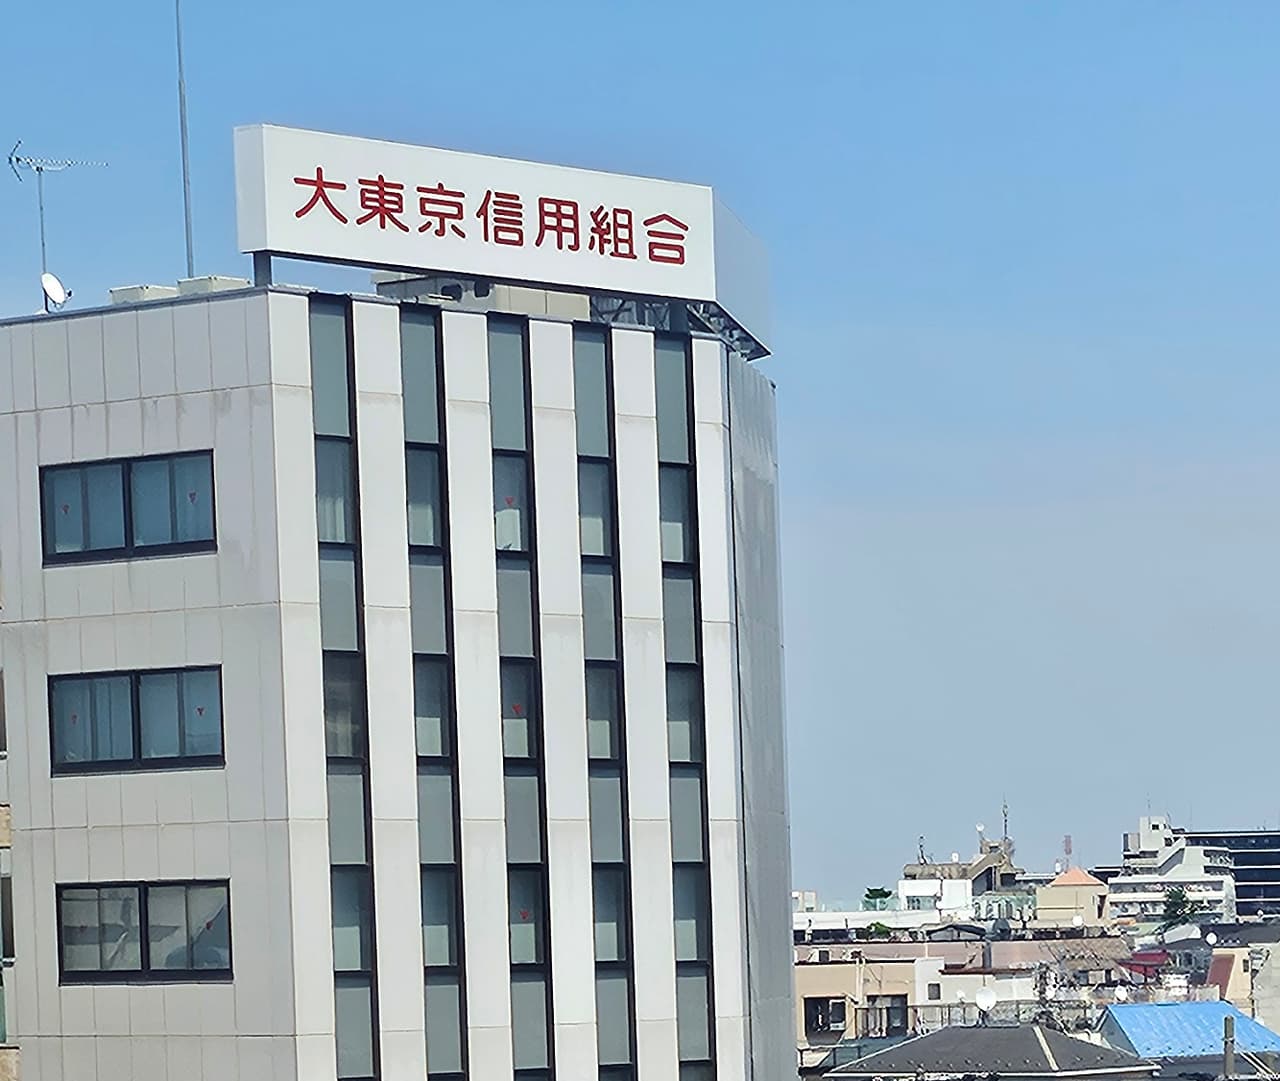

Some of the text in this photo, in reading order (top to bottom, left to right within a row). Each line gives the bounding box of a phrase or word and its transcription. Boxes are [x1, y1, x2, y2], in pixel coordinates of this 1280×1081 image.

[293, 166, 690, 266] 大東京信用組合
